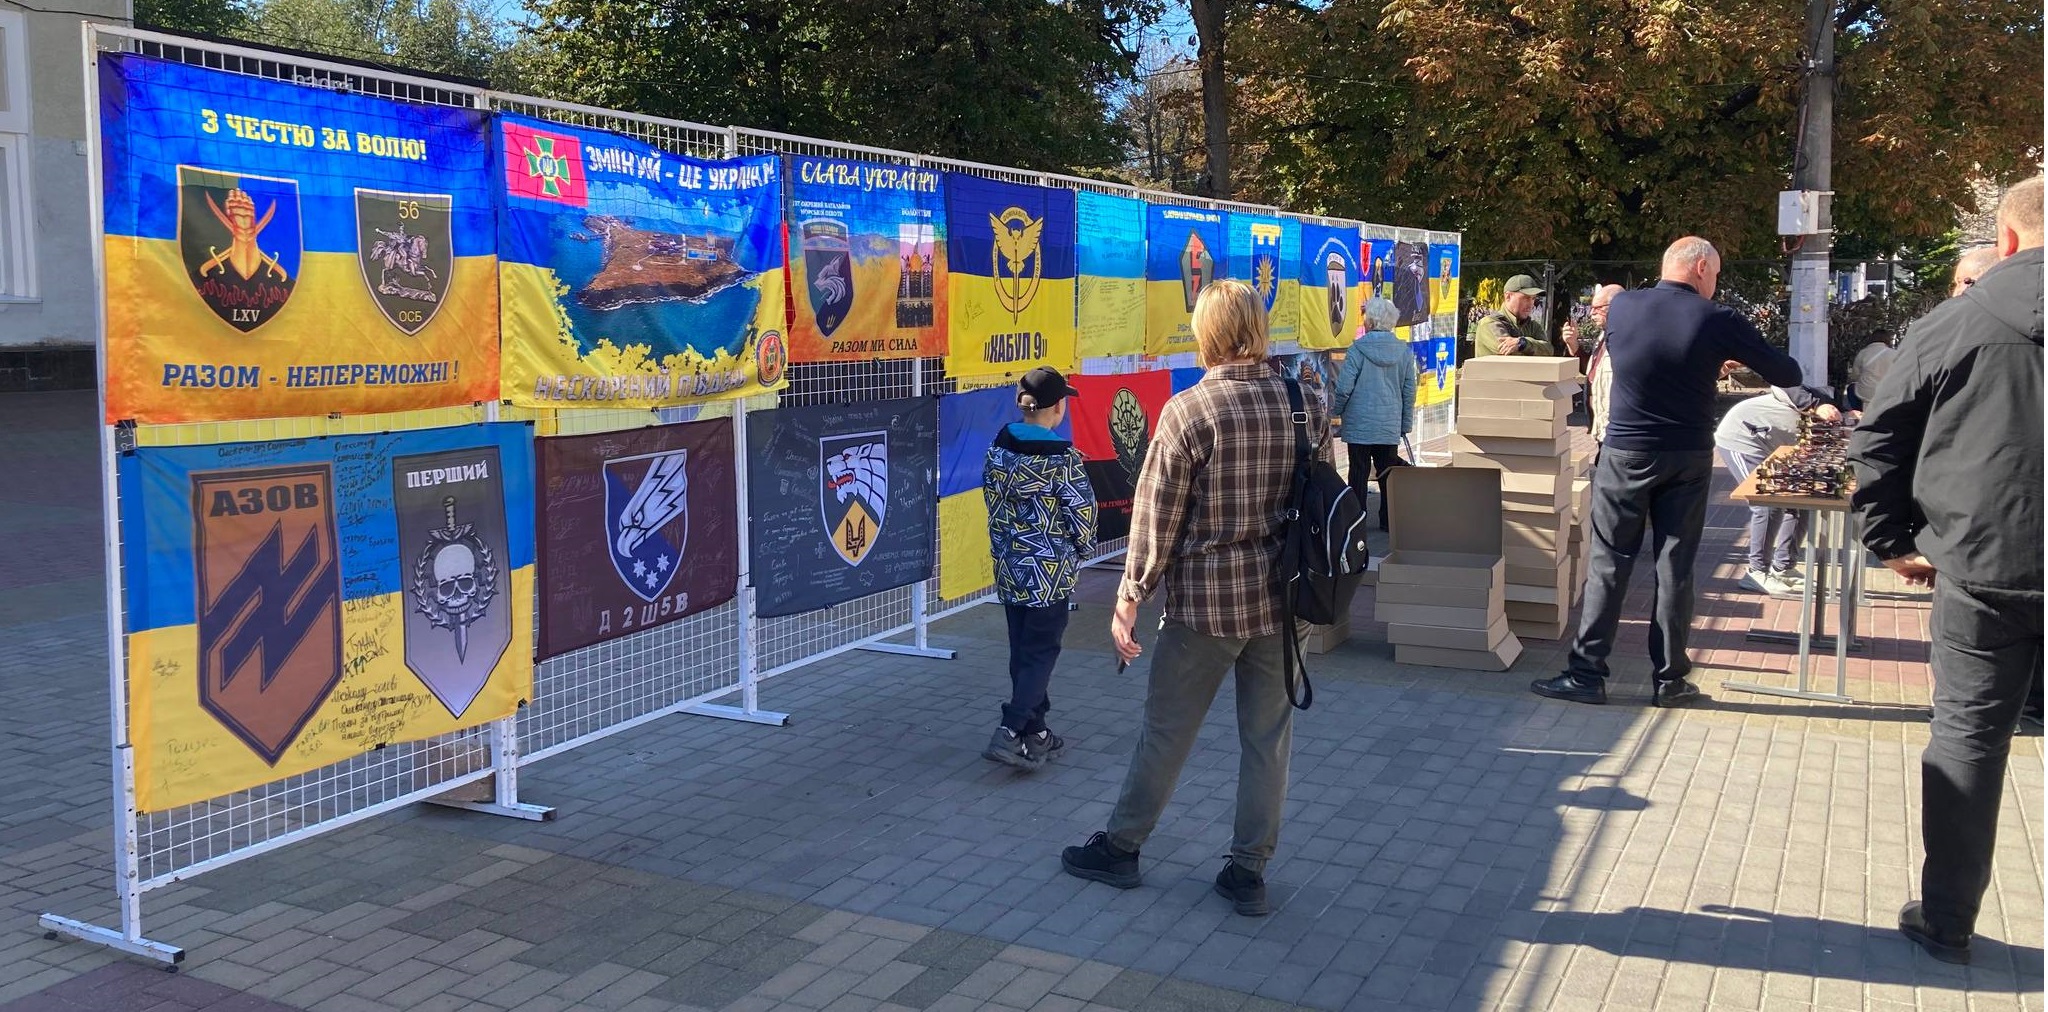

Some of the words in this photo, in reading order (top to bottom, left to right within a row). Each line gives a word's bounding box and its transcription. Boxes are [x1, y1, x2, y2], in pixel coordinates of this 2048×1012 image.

[201, 108, 219, 134] З
[225, 113, 315, 148] ЧЕСТЮ
[321, 126, 351, 151] ЗА
[356, 131, 428, 161] ВОЛЮ!
[678, 163, 704, 190] ЦЕ
[801, 161, 861, 187] СЛАВА
[863, 168, 940, 193] УКРАЇНІ!
[398, 200, 420, 220] 56
[232, 308, 261, 322] LXV
[398, 310, 423, 322] ОСБ
[831, 340, 868, 354] РАЗОМ
[869, 339, 886, 352] МИ
[888, 338, 918, 351] СИЛА
[161, 363, 261, 389] РАЗОМ
[286, 361, 449, 388] НЕПЕРЕМОЖНІ
[533, 365, 673, 401] НЕСКОРЕНИЙ
[676, 369, 751, 397] ПІВДЕНЬ
[406, 459, 489, 488] ПЕРШИЙ
[209, 483, 319, 518] АЗОВ
[599, 609, 611, 636] Д
[622, 606, 634, 629] 2
